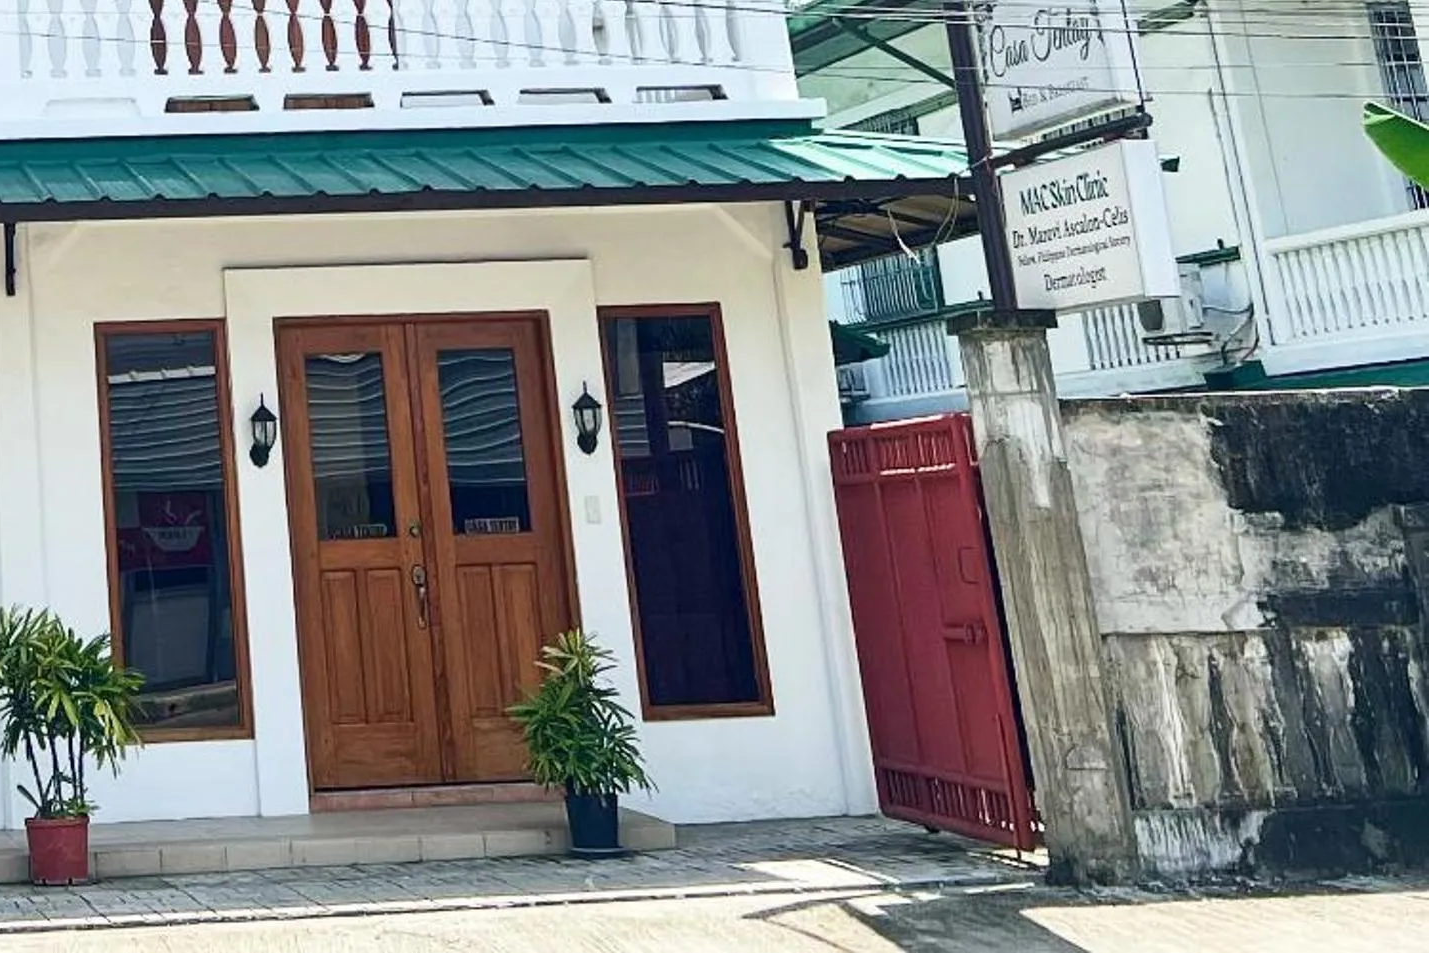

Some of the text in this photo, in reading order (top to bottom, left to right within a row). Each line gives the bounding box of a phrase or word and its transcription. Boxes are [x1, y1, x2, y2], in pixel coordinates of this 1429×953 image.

[990, 24, 1029, 78] Casa
[1019, 169, 1110, 216] MAC Skin Clinic
[1012, 230, 1028, 249] Dr.
